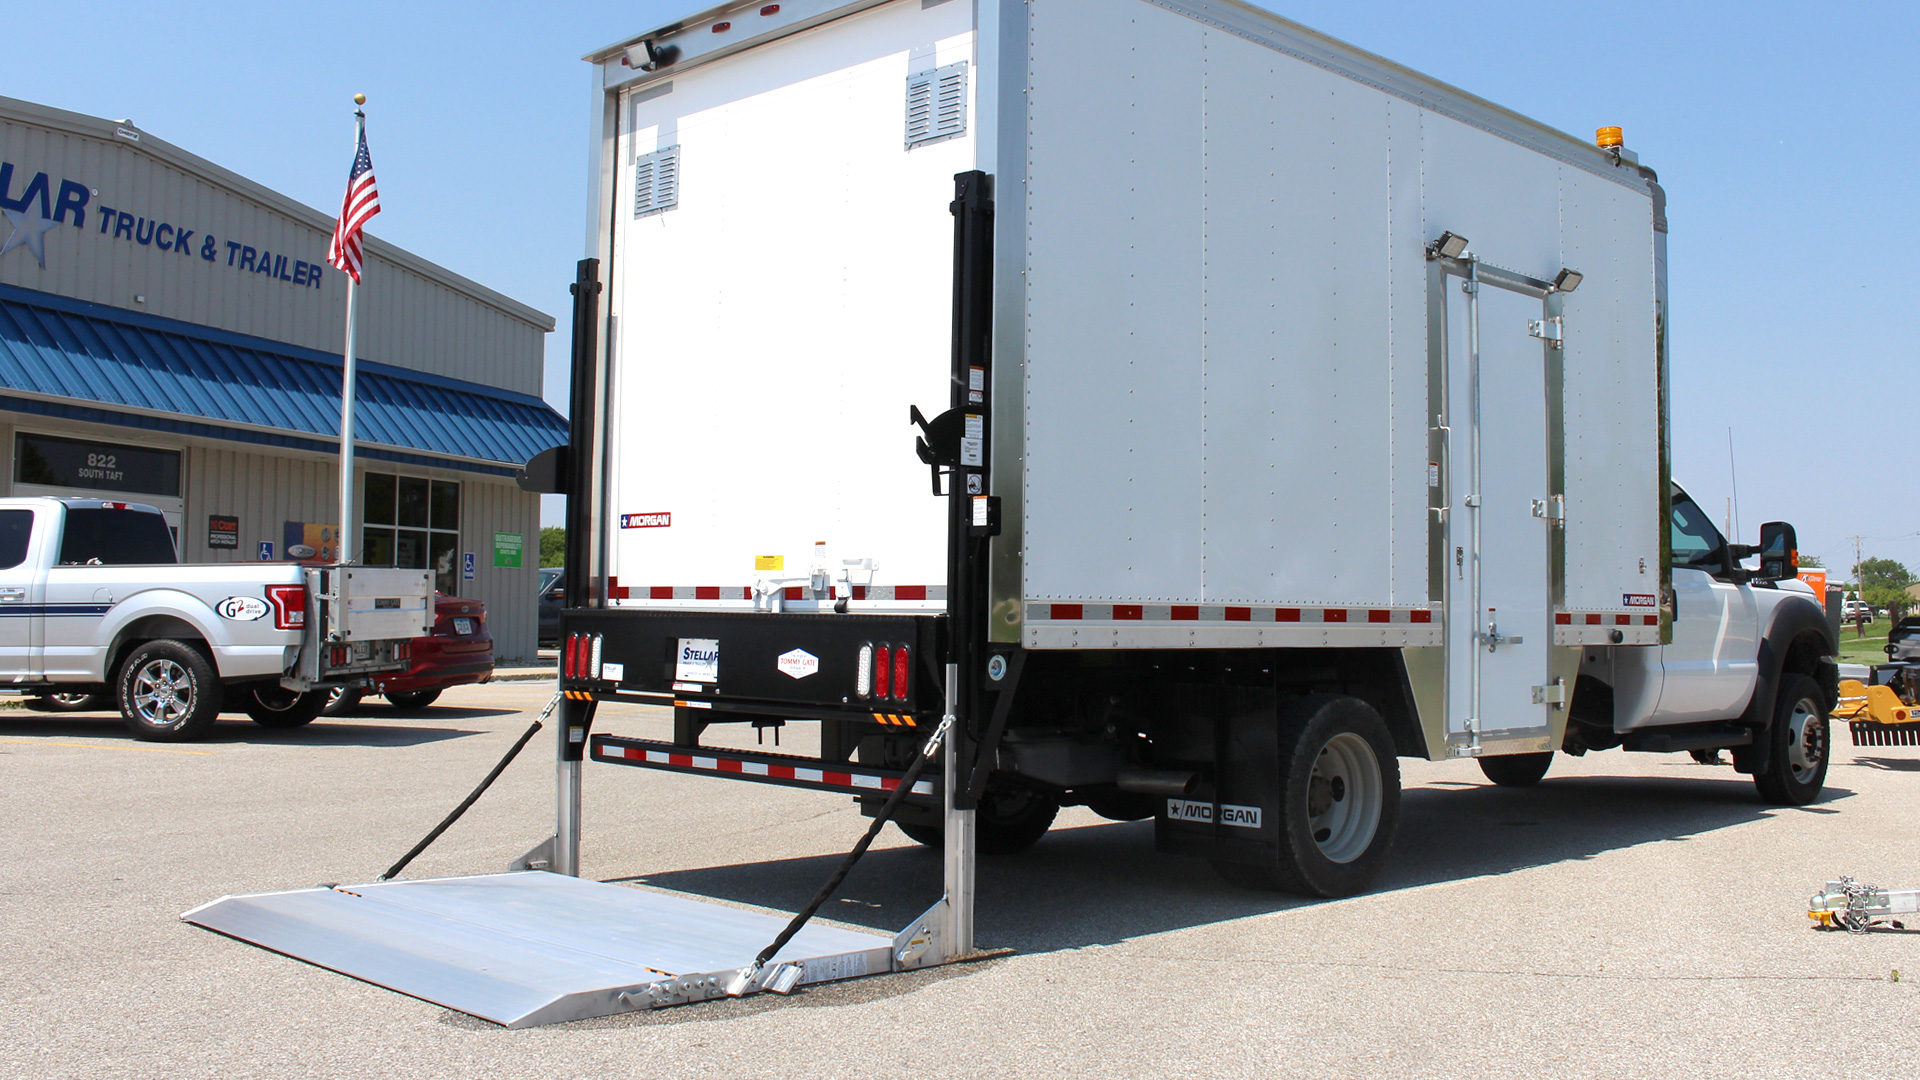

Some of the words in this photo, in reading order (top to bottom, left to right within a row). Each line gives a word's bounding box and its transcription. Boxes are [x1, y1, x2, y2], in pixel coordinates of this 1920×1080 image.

[99, 205, 195, 256] TRUCK
[200, 234, 217, 262] &
[225, 240, 323, 289] TRAILER
[87, 453, 116, 469] 822
[78, 468, 104, 480] SOUTH
[105, 470, 124, 481] TAFT
[629, 514, 670, 527] MORGAN
[1629, 595, 1654, 606] MORGAN
[780, 657, 801, 666] TOMMY
[802, 659, 817, 667] GATE
[1184, 804, 1257, 823] MOGAN
